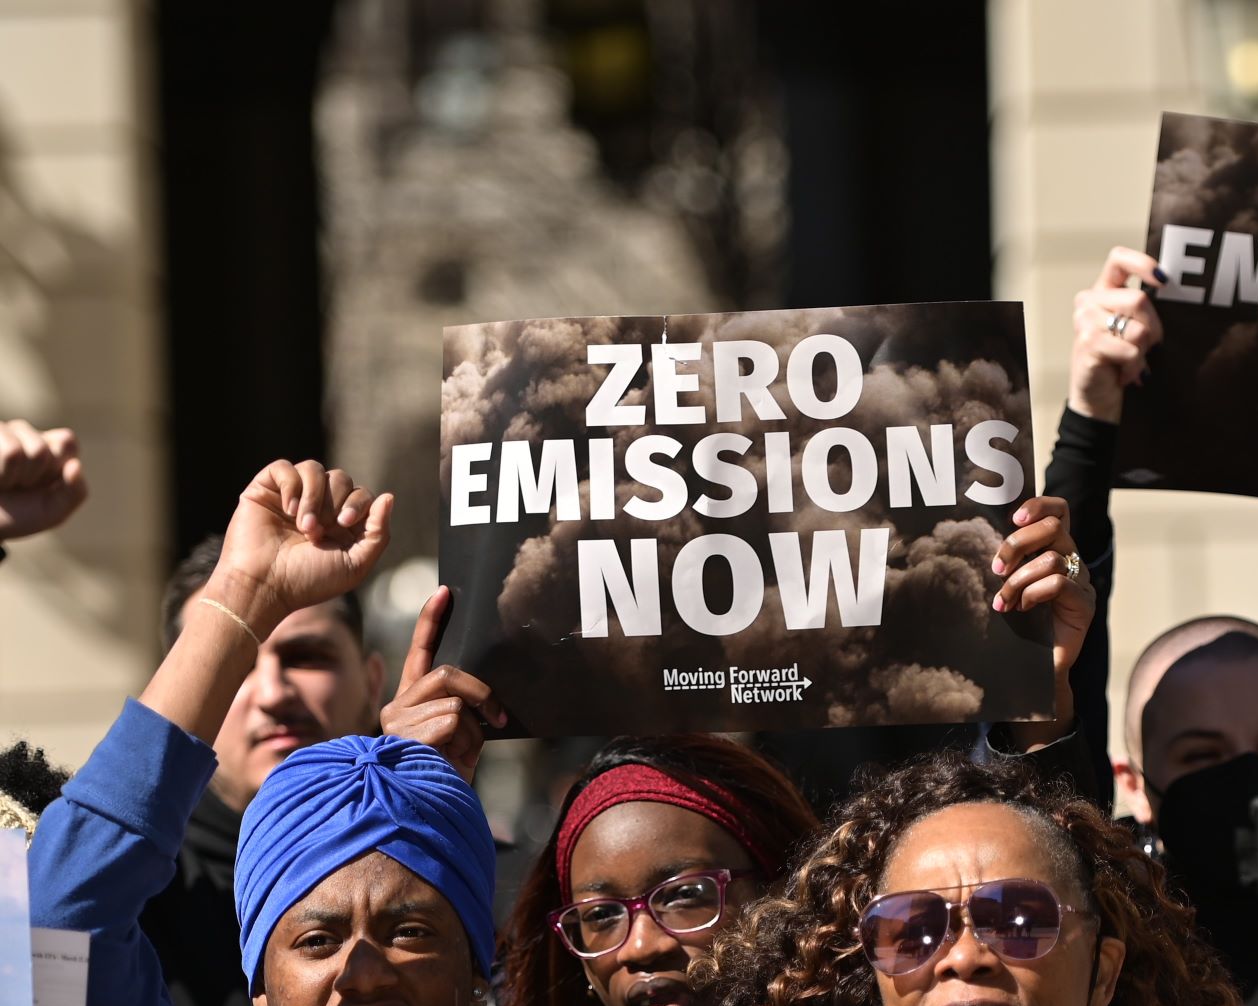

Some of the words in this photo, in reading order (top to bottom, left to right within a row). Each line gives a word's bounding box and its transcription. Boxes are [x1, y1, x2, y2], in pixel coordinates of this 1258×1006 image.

[586, 333, 863, 427] ZERO
[449, 420, 1025, 527] EMISSIONS
[577, 527, 890, 639] NOW
[663, 667, 726, 688] Moving
[729, 663, 799, 684] Forward
[731, 684, 803, 704] Network
